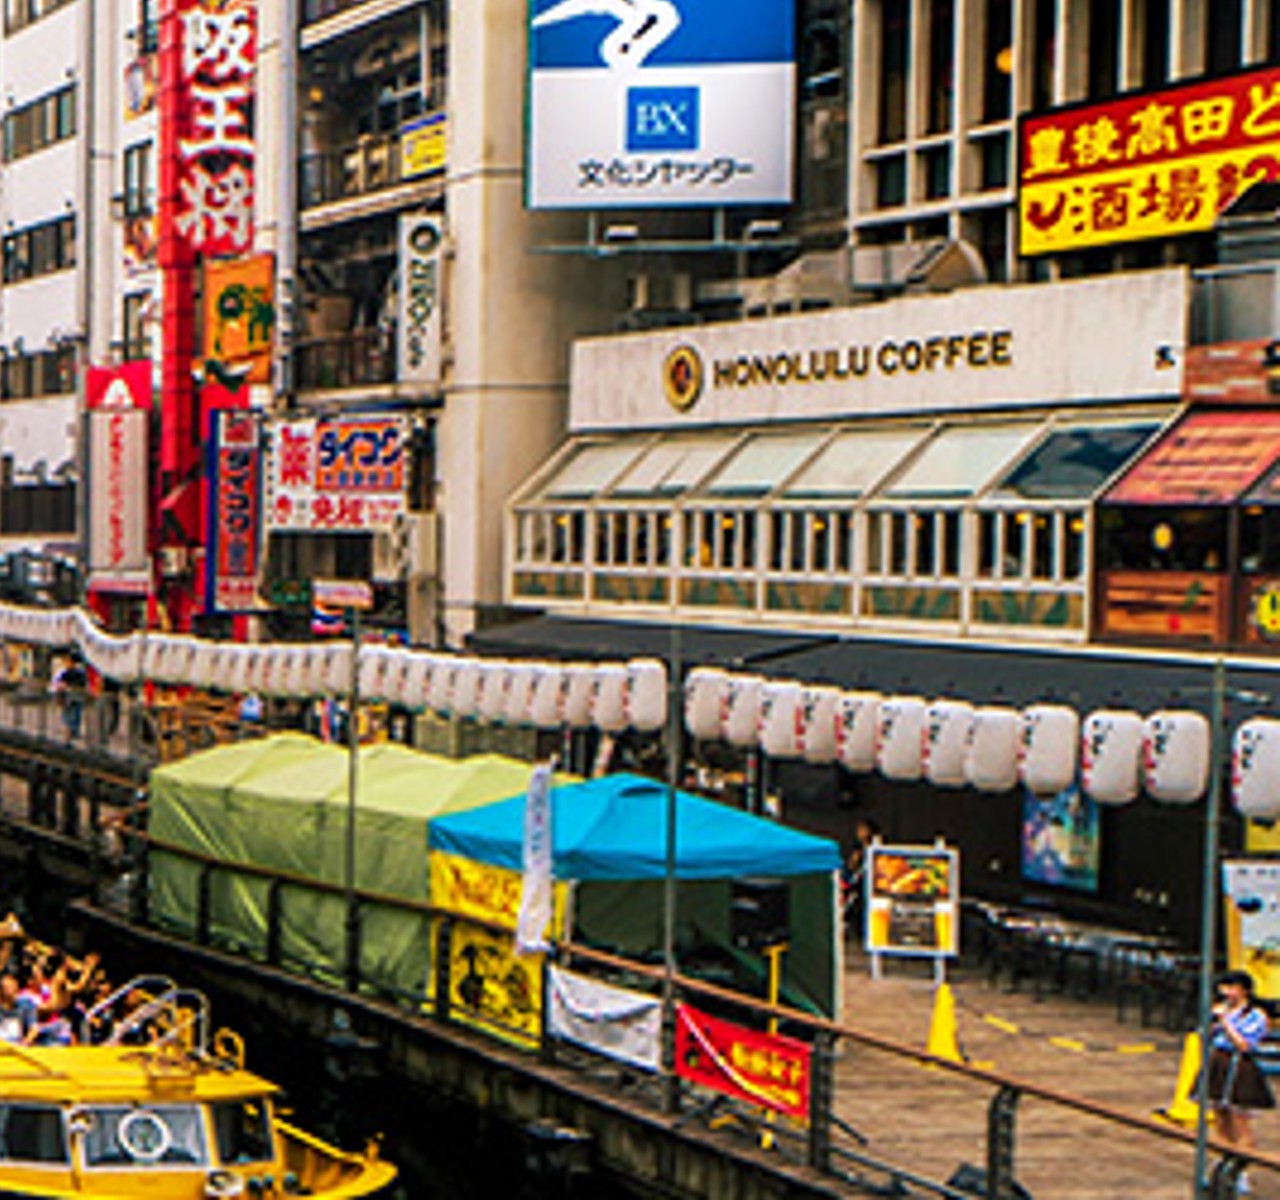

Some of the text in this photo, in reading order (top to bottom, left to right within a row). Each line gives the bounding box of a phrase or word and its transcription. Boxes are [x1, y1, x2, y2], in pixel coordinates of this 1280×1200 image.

[637, 101, 688, 134] BX
[578, 158, 755, 188] 文化シャッター
[713, 330, 1013, 388] HONOLULU COFFEE
[320, 428, 399, 466] ダイコク
